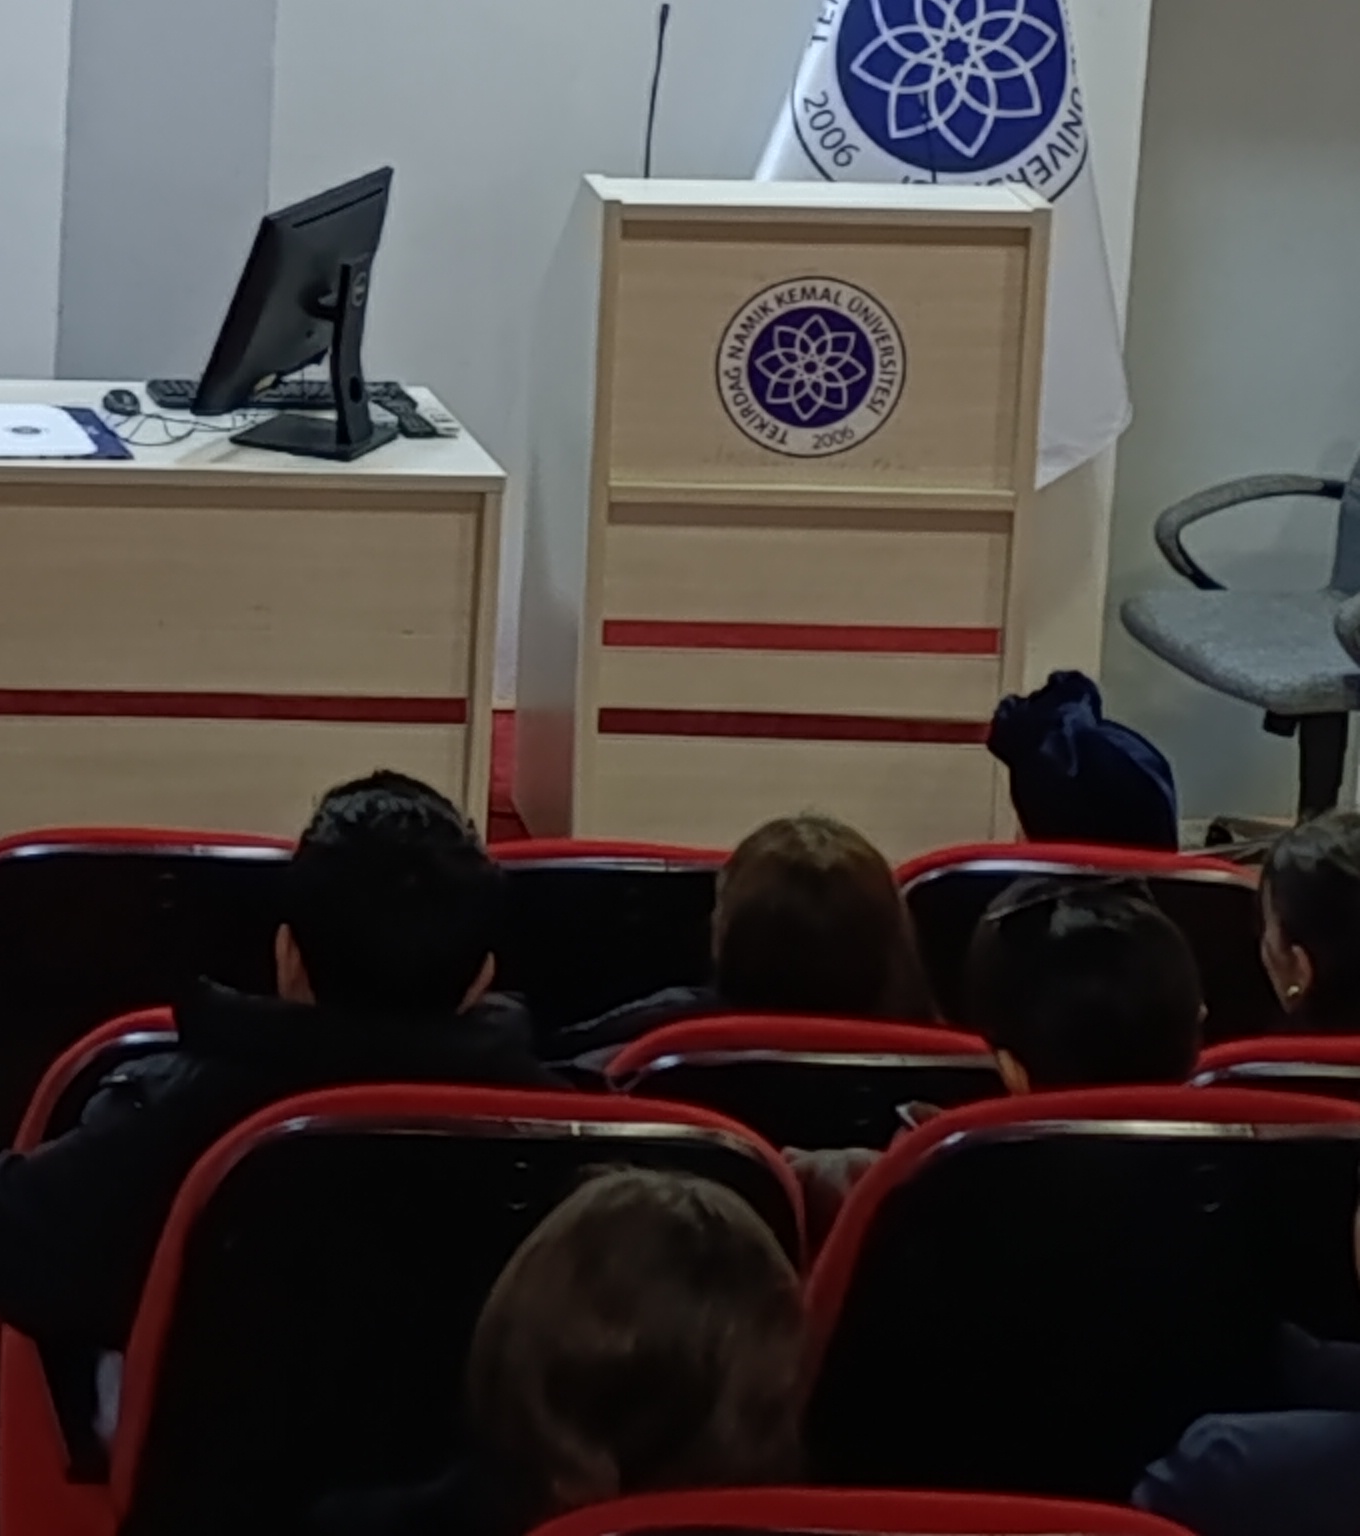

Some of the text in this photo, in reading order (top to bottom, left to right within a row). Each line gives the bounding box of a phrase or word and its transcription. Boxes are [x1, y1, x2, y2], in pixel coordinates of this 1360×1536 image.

[803, 91, 860, 167] 2006
[724, 286, 898, 446] TEKİRDAĞ NAMIK KEMAL ÜNİVERSİTESİ
[812, 426, 856, 451] 2006
